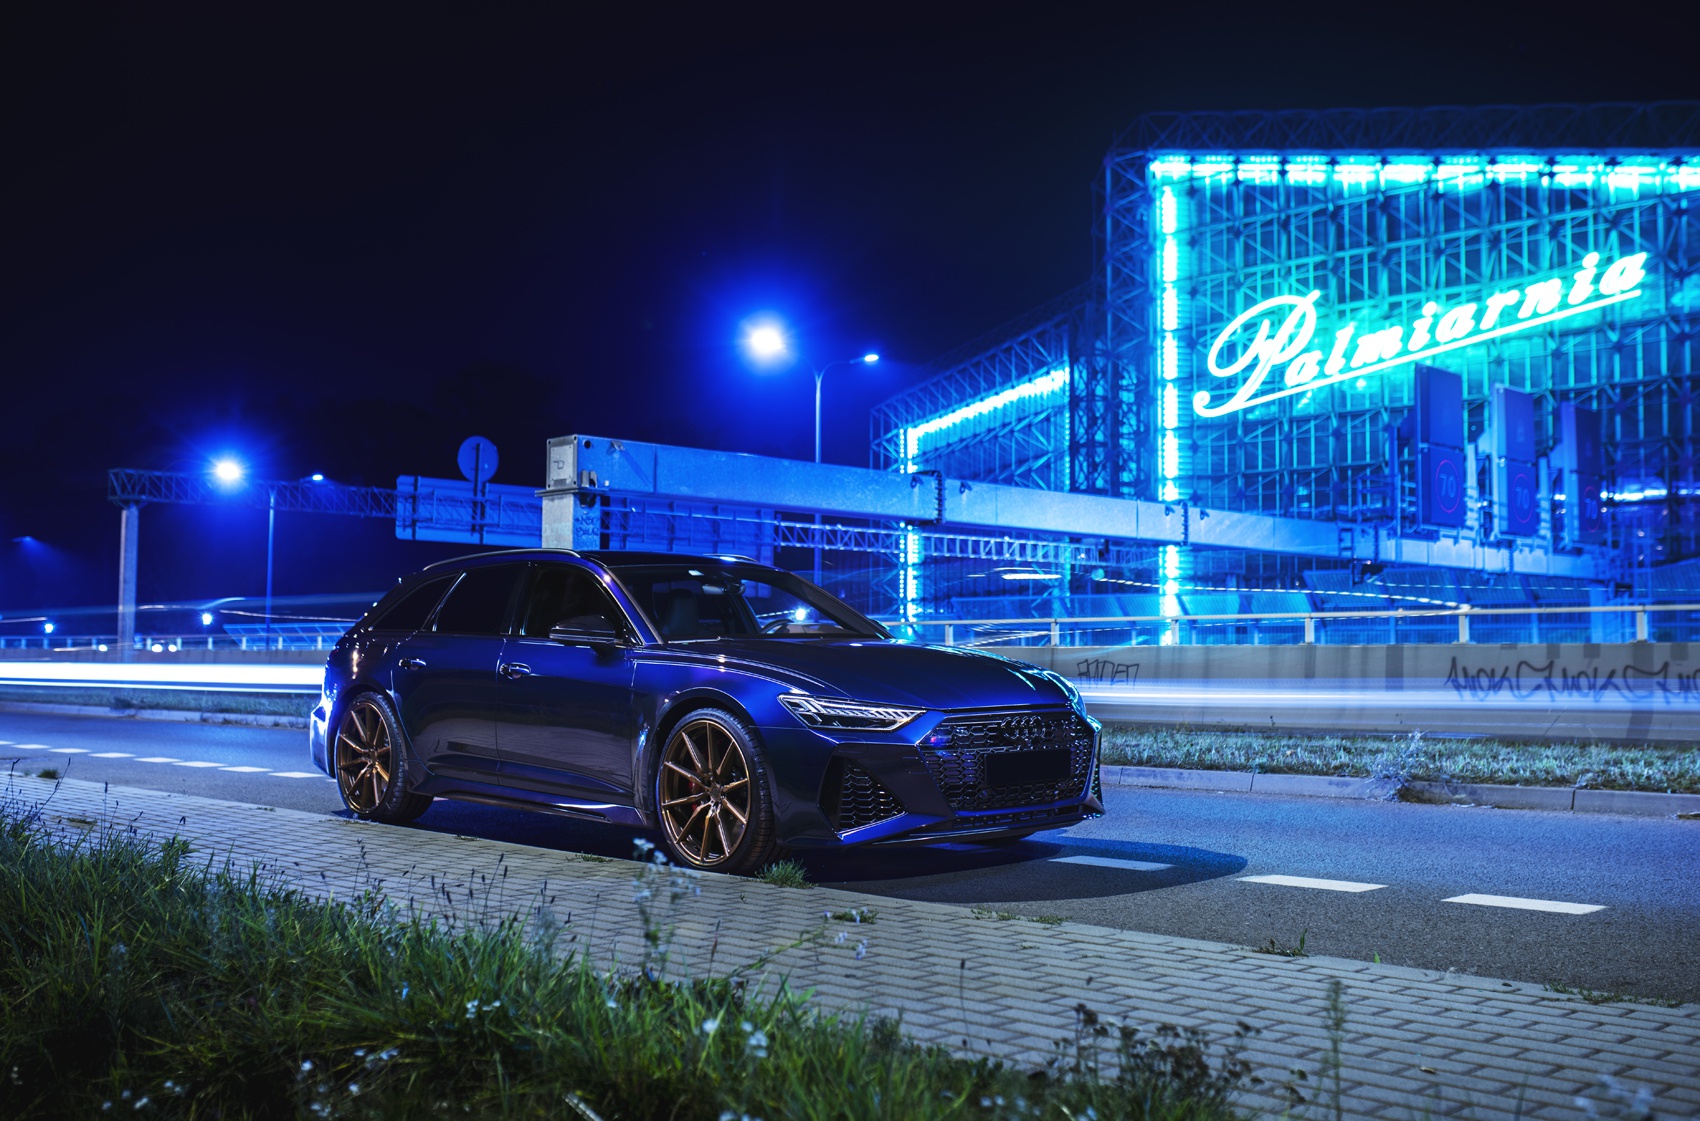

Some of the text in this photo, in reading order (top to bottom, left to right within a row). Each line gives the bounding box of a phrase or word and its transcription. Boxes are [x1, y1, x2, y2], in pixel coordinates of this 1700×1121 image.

[1193, 251, 1647, 417] Palmiarnia
[1439, 473, 1457, 498] 70
[1515, 487, 1531, 510] 70
[1584, 498, 1598, 520] 70
